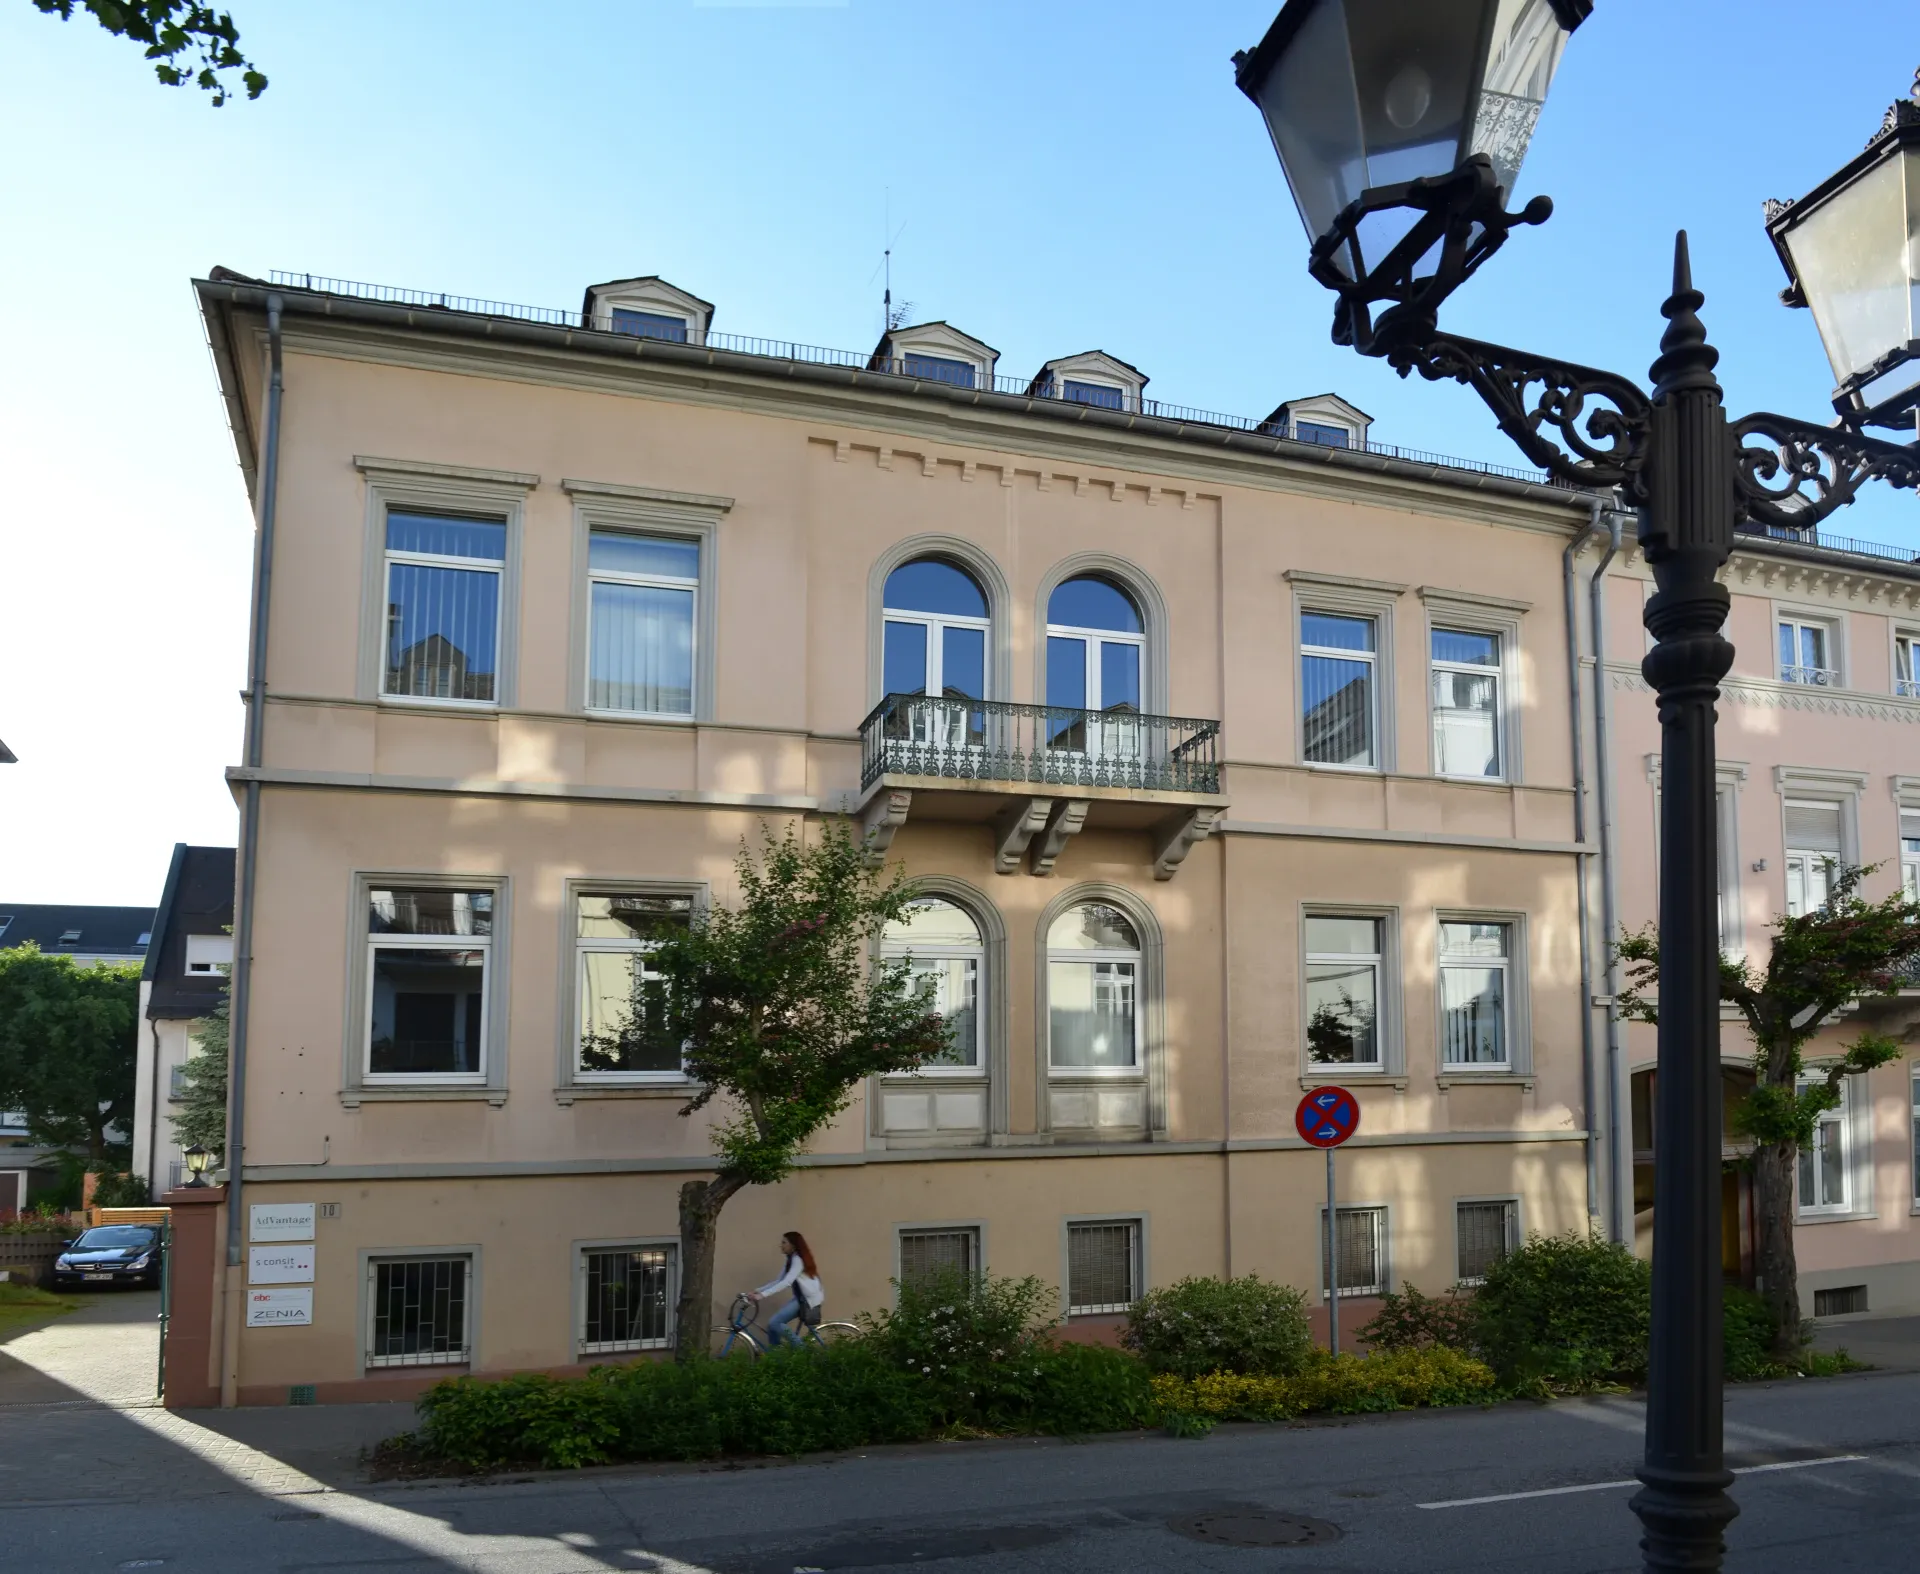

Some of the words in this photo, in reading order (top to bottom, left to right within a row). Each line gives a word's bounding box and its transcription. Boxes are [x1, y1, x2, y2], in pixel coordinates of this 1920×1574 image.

[322, 1205, 335, 1216] 10
[255, 1216, 311, 1225] AdVantage
[253, 1294, 271, 1302] ebc
[253, 1309, 305, 1319] ZENIA
